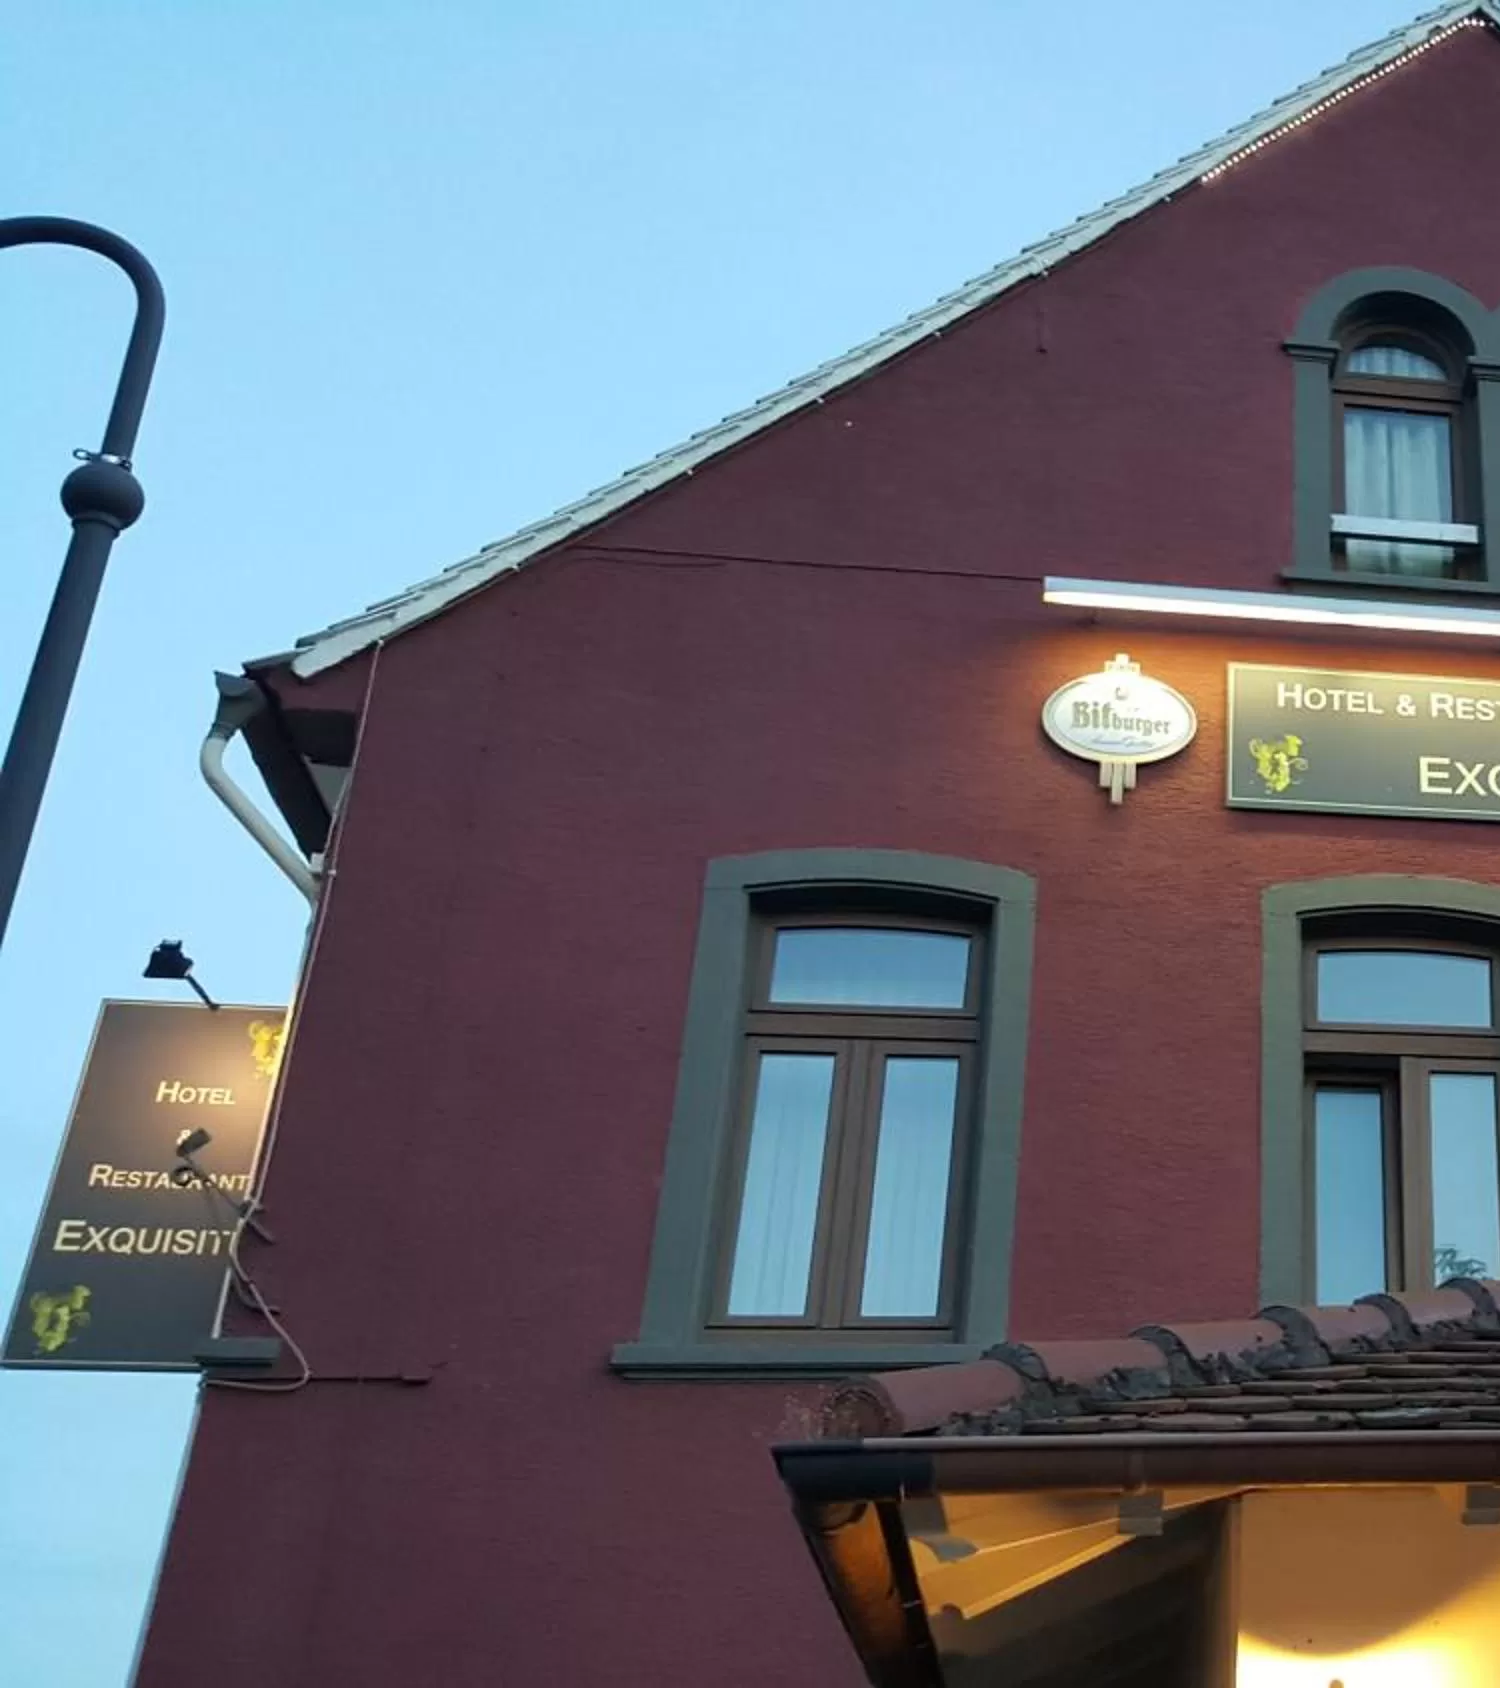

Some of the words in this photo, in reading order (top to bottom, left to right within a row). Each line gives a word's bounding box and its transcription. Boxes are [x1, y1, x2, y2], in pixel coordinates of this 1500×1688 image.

[1276, 681, 1385, 715] HOTEL
[1395, 693, 1417, 717] &
[1071, 700, 1172, 737] Bitburger
[155, 1080, 236, 1105] HOTEL
[53, 1219, 237, 1256] EXQUISIT
